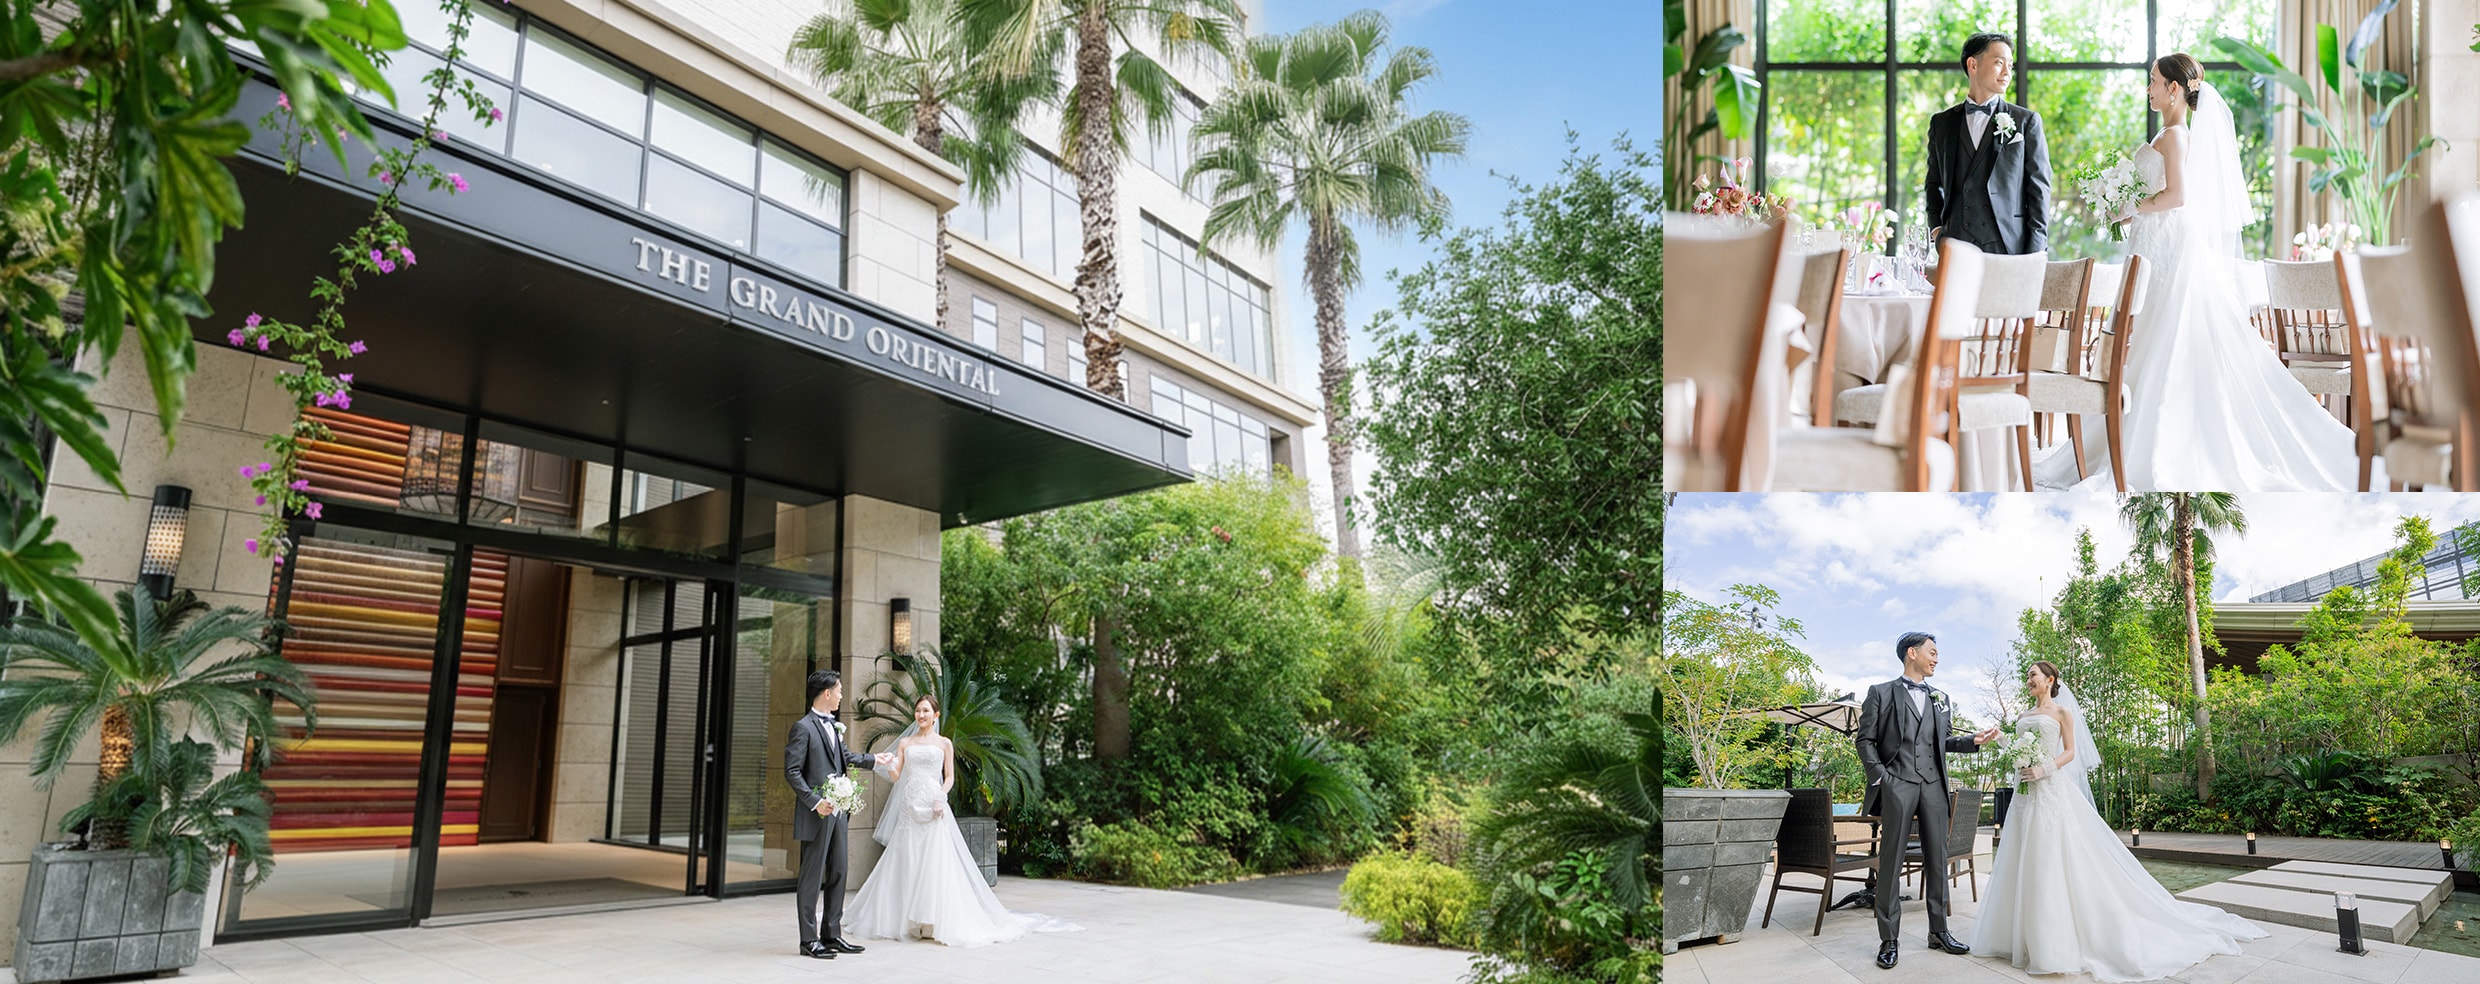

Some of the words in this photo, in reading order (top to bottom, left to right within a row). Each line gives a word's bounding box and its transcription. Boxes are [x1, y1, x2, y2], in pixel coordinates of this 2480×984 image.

[632, 237, 710, 292] THE
[730, 276, 854, 342] GRAND
[866, 327, 1000, 396] ORIENTAL
